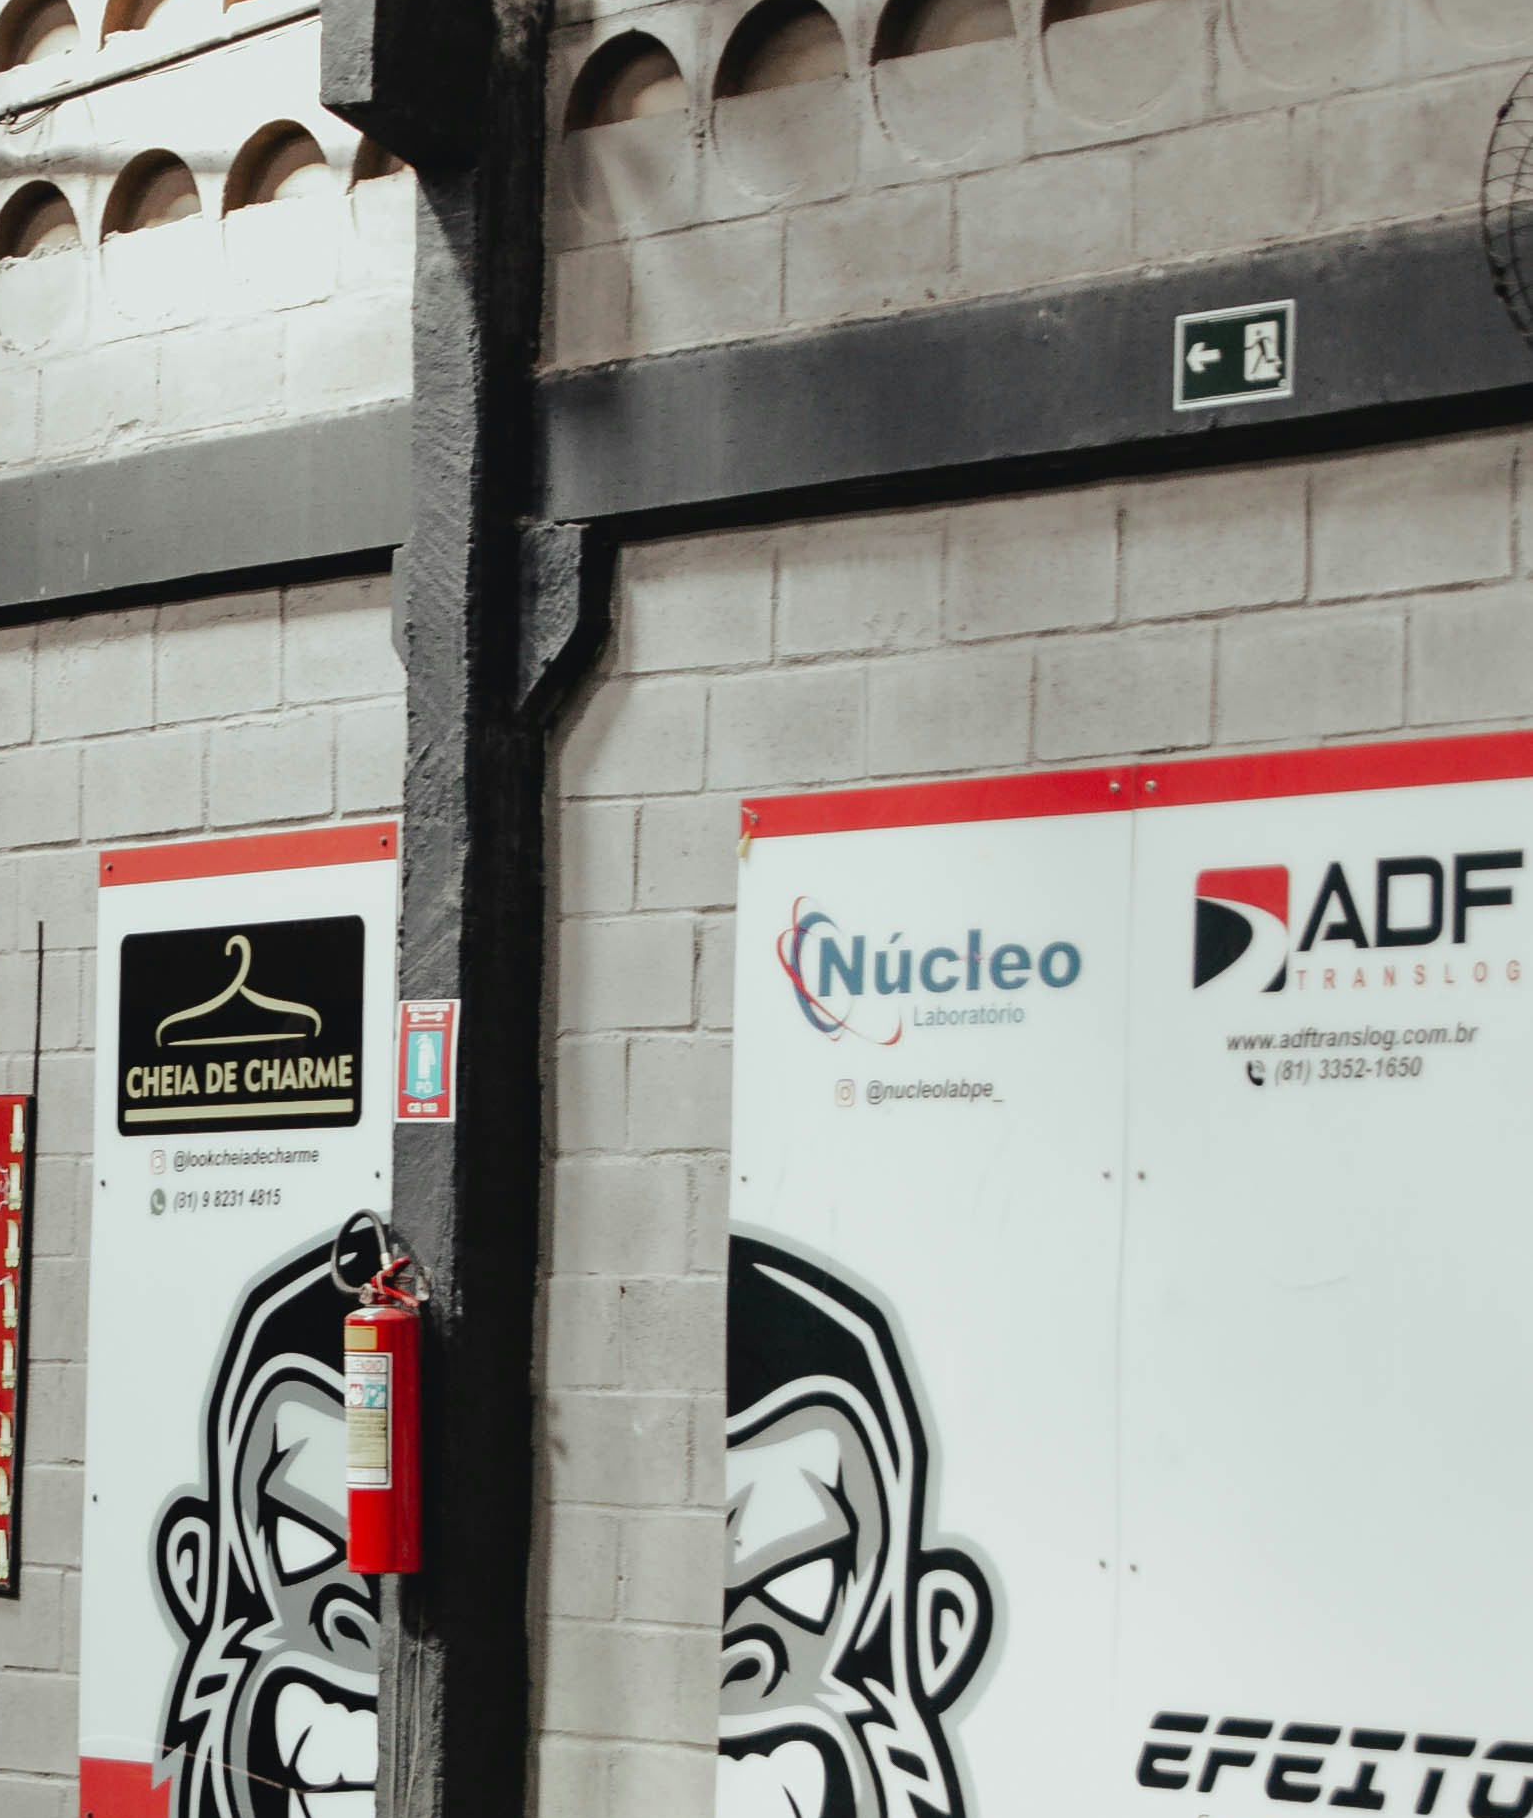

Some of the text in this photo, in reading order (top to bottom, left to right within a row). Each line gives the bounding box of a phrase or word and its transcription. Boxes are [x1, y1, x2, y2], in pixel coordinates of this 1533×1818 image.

[1296, 849, 1524, 952] ADF
[818, 928, 1081, 997] Núcleo
[1295, 959, 1522, 990] TRANSLOG
[913, 1003, 1026, 1027] Laboratório
[1226, 1021, 1479, 1052] www.adftranslog.com.br
[125, 1054, 354, 1099] CHEIA DE CHARME
[1274, 1055, 1424, 1087] (81) 3352-1650
[865, 1078, 1005, 1106] @nucleolabpe_
[173, 1148, 320, 1173] @lookcheiadecharme
[202, 1190, 211, 1208] 9
